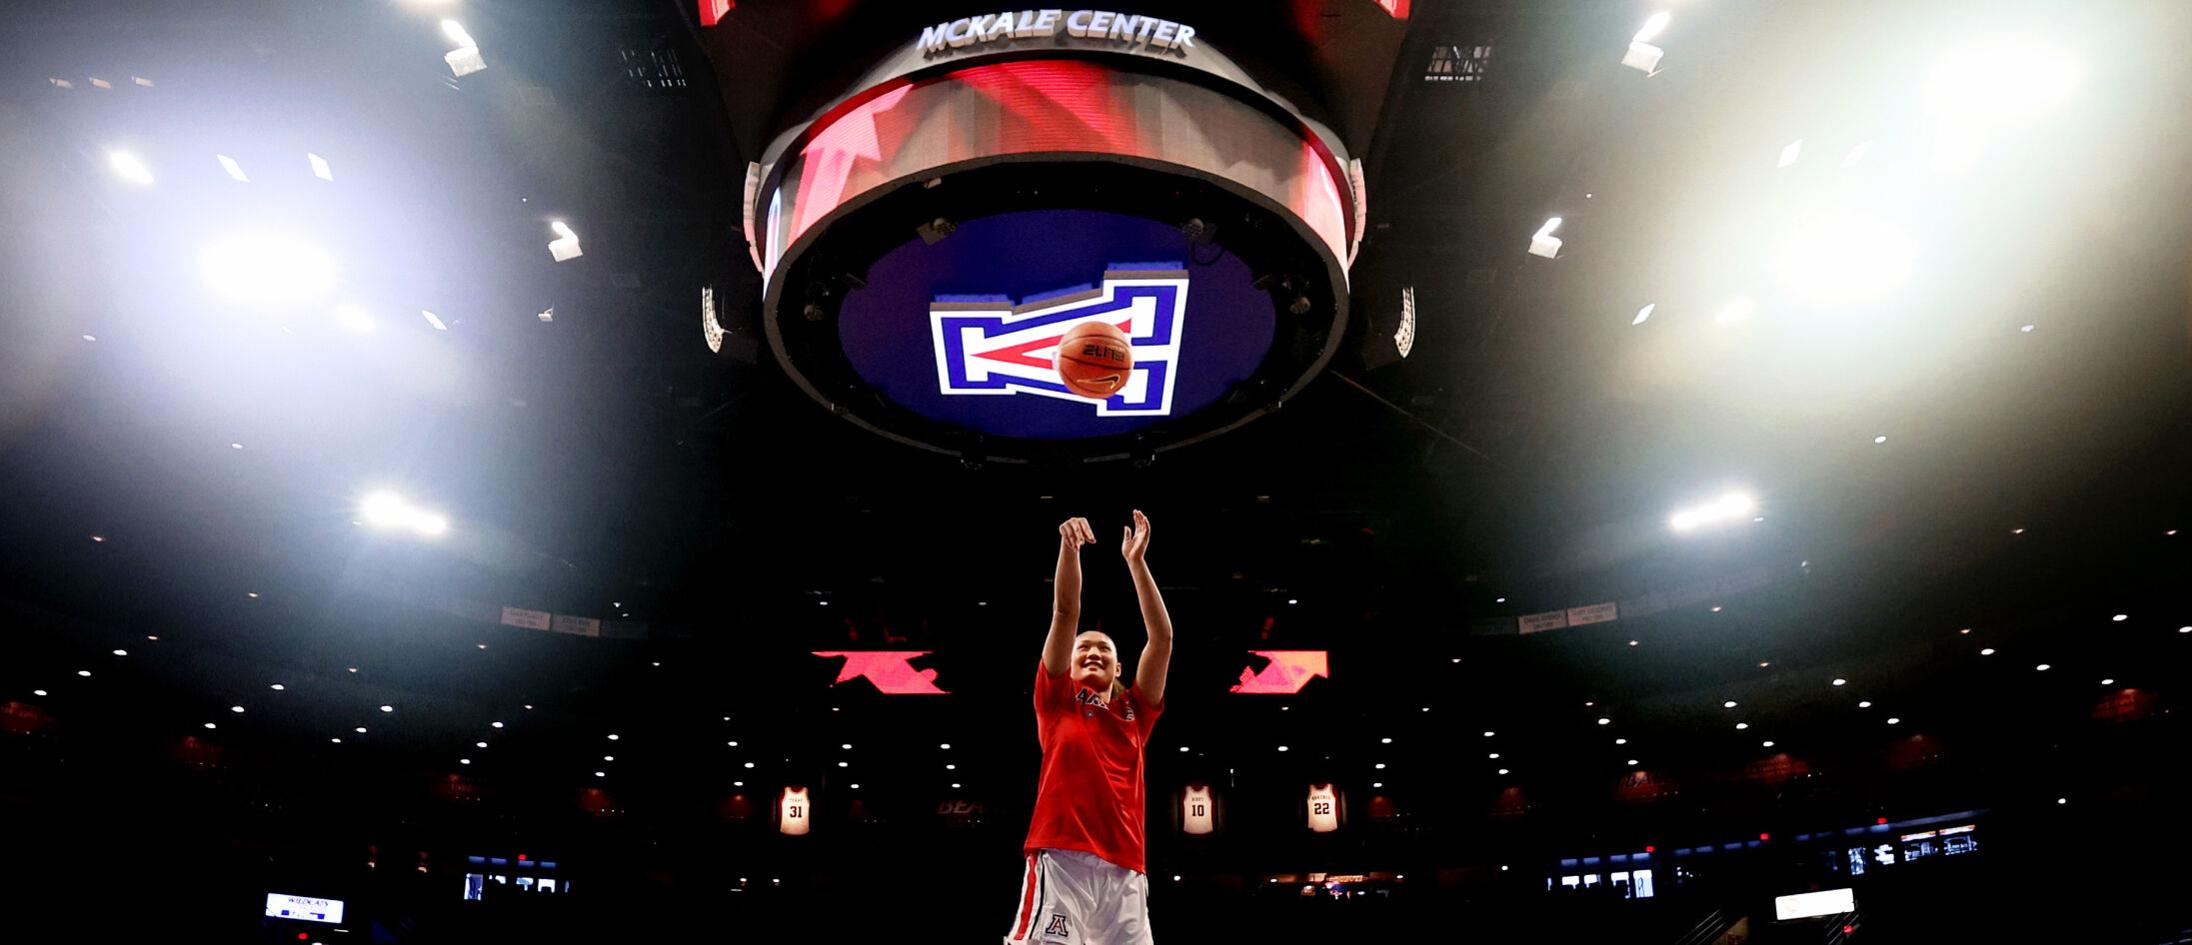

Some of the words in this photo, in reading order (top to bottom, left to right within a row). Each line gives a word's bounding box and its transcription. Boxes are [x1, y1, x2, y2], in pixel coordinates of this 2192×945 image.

[1067, 9, 1197, 48] CENTER
[789, 805, 803, 819] 31
[1191, 804, 1205, 817] 10
[1314, 802, 1330, 815] 22
[1045, 914, 1069, 938] A
